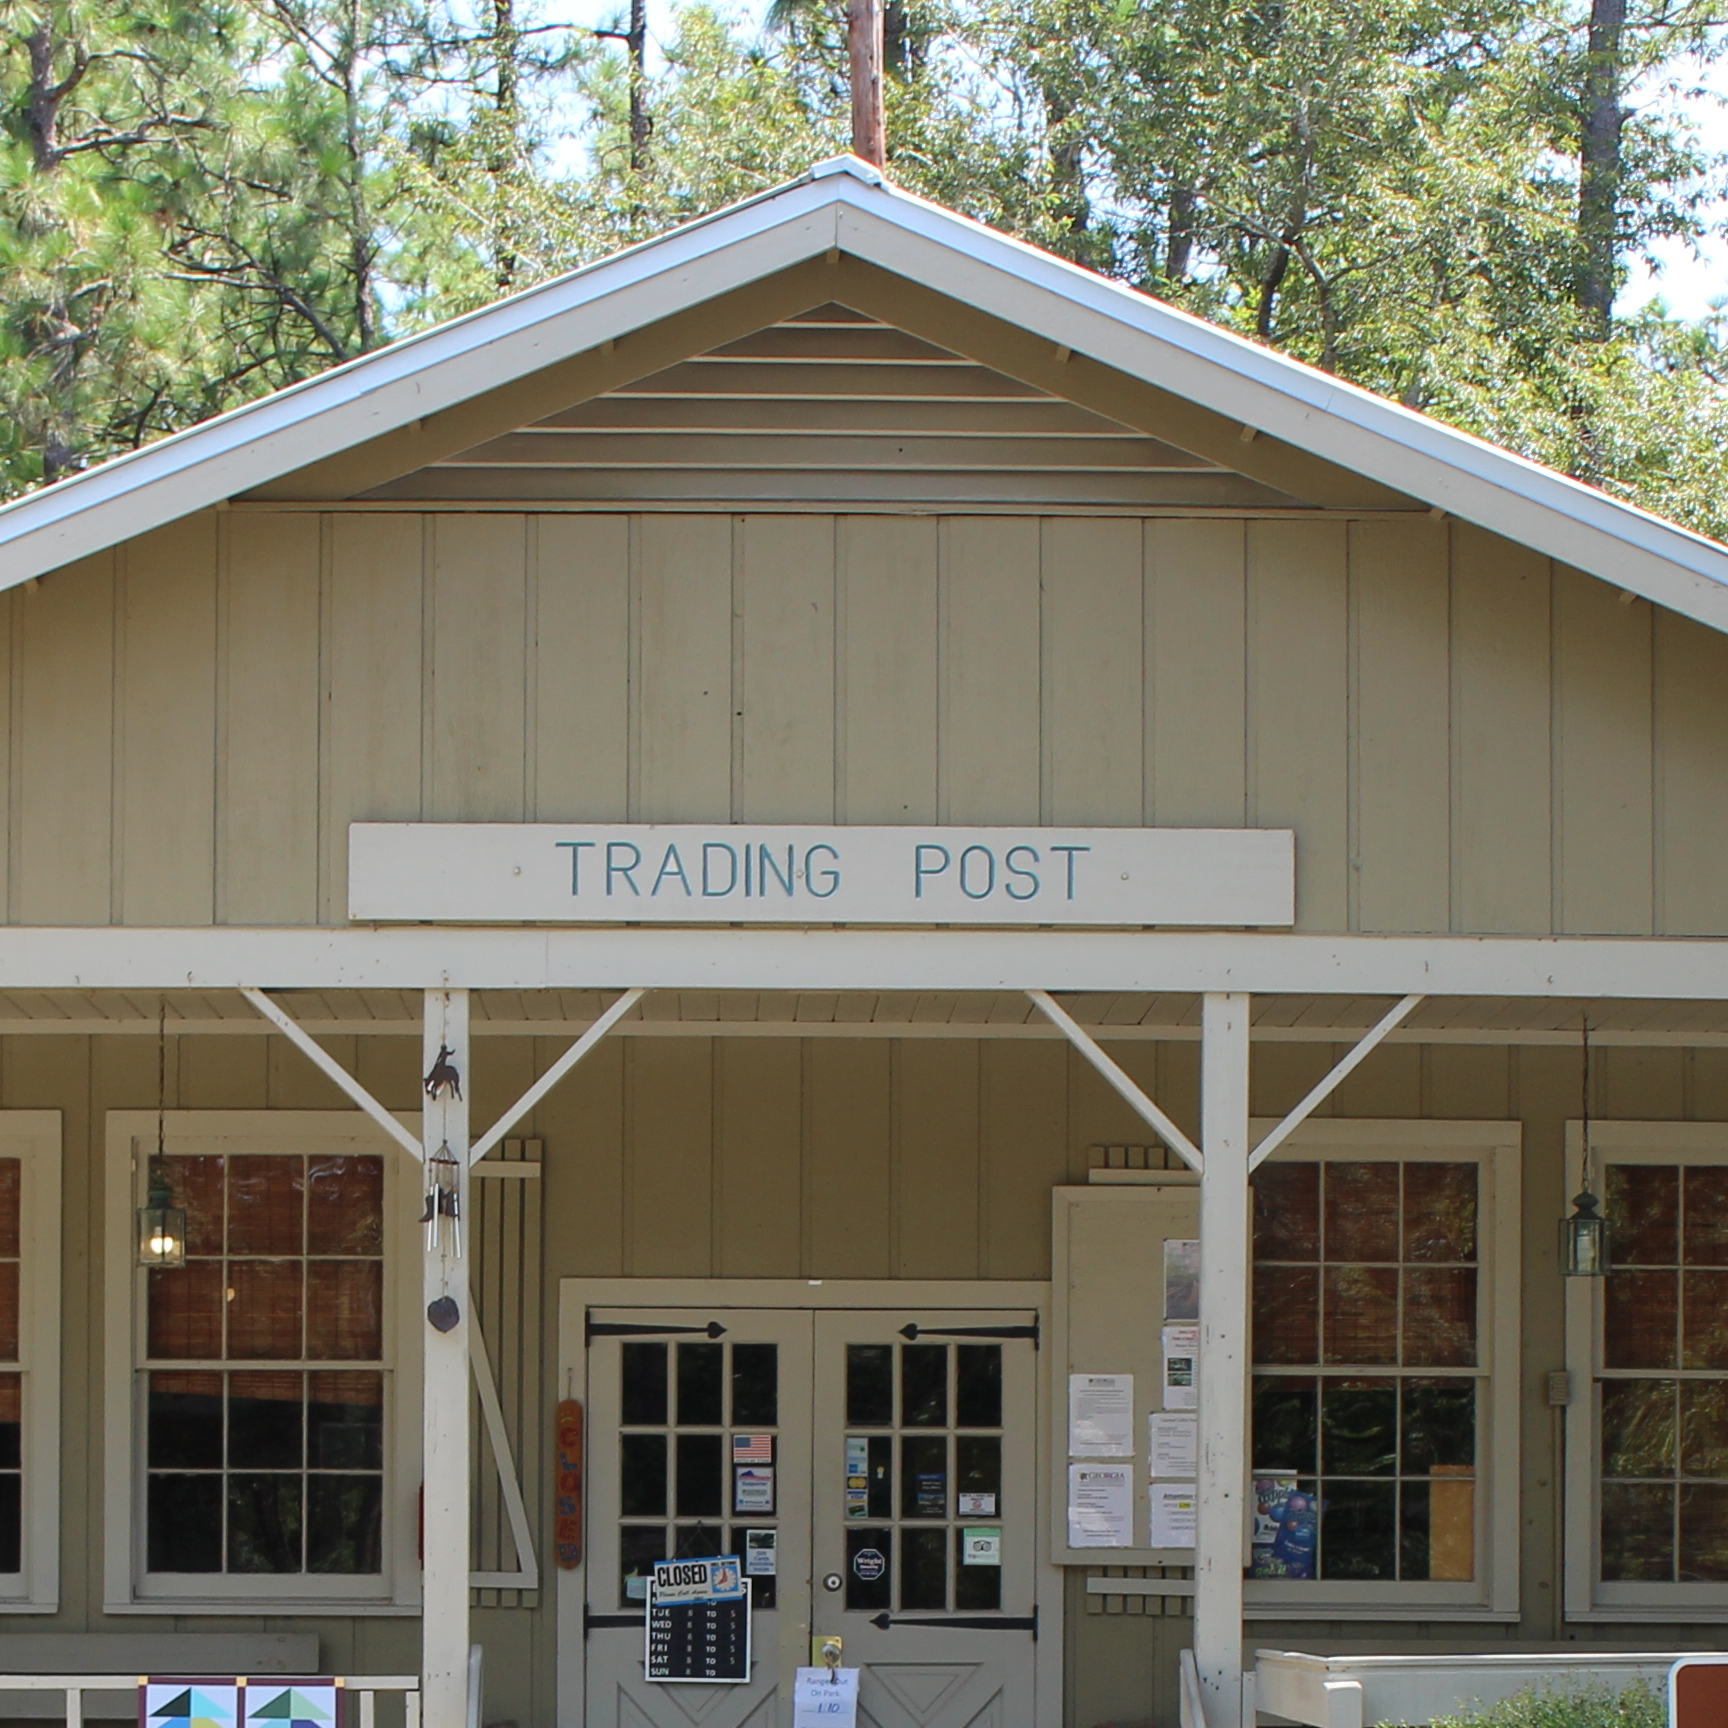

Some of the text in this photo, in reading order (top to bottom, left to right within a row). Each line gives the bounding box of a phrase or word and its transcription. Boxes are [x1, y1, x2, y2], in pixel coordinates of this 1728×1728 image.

[555, 841, 1091, 901] TRADING POST
[559, 1426, 581, 1563] CLOSED
[657, 1563, 708, 1588] CLOSED
[651, 1608, 670, 1617] TUE
[706, 1610, 717, 1618] TO
[651, 1620, 672, 1628] WED
[706, 1622, 717, 1630] TO
[651, 1632, 671, 1640] THU
[706, 1633, 717, 1641] TO
[651, 1643, 668, 1652] FRI
[705, 1645, 716, 1653] TO
[650, 1655, 669, 1664] SAT
[705, 1657, 716, 1665] TO
[650, 1667, 670, 1676] SUN
[705, 1668, 716, 1677] TO
[806, 1677, 834, 1686] Range
